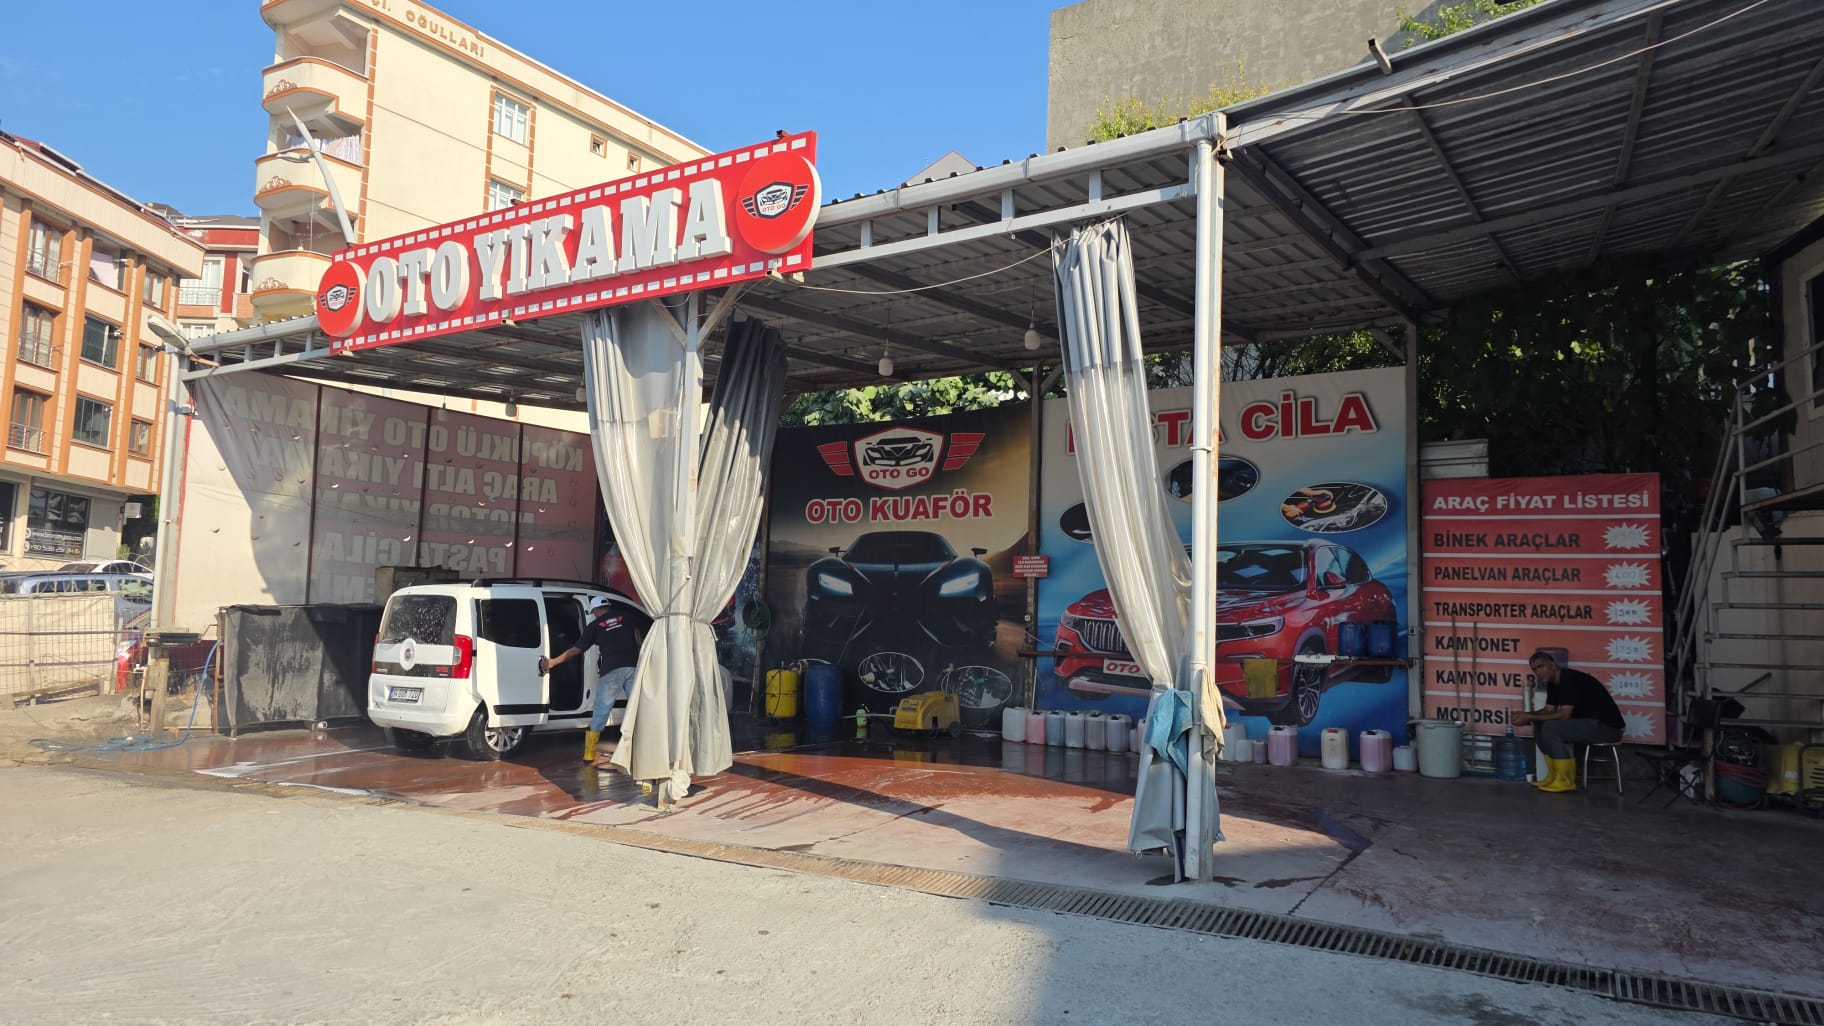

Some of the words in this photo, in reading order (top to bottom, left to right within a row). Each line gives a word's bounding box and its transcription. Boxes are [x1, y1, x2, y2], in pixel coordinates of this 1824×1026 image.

[405, 9, 485, 58] OĞULLARI
[762, 205, 776, 213] OTO
[366, 240, 469, 323] OTO
[473, 178, 733, 300] YIKAMA
[1239, 390, 1378, 441] CİLA
[869, 468, 900, 480] OTO
[906, 467, 930, 478] GO
[806, 498, 863, 524] OTO
[869, 488, 993, 523] KUAFÖR
[1433, 496, 1489, 512] ARAÇ
[1496, 493, 1556, 509] FİYAT
[1563, 490, 1649, 508] LİSTESİ
[1434, 532, 1488, 548] BİNEK
[1494, 533, 1581, 550] ARAÇLAR
[1434, 566, 1507, 581] PANELVAN
[1511, 568, 1581, 585] ARAÇLAR
[1434, 602, 1527, 617] TRANSPORTER
[1531, 604, 1593, 621] ARAÇLAR
[1435, 636, 1520, 652] KAMYONET
[1106, 662, 1141, 674] OTO
[1436, 670, 1500, 687] KAMYON
[1502, 674, 1522, 688] VE
